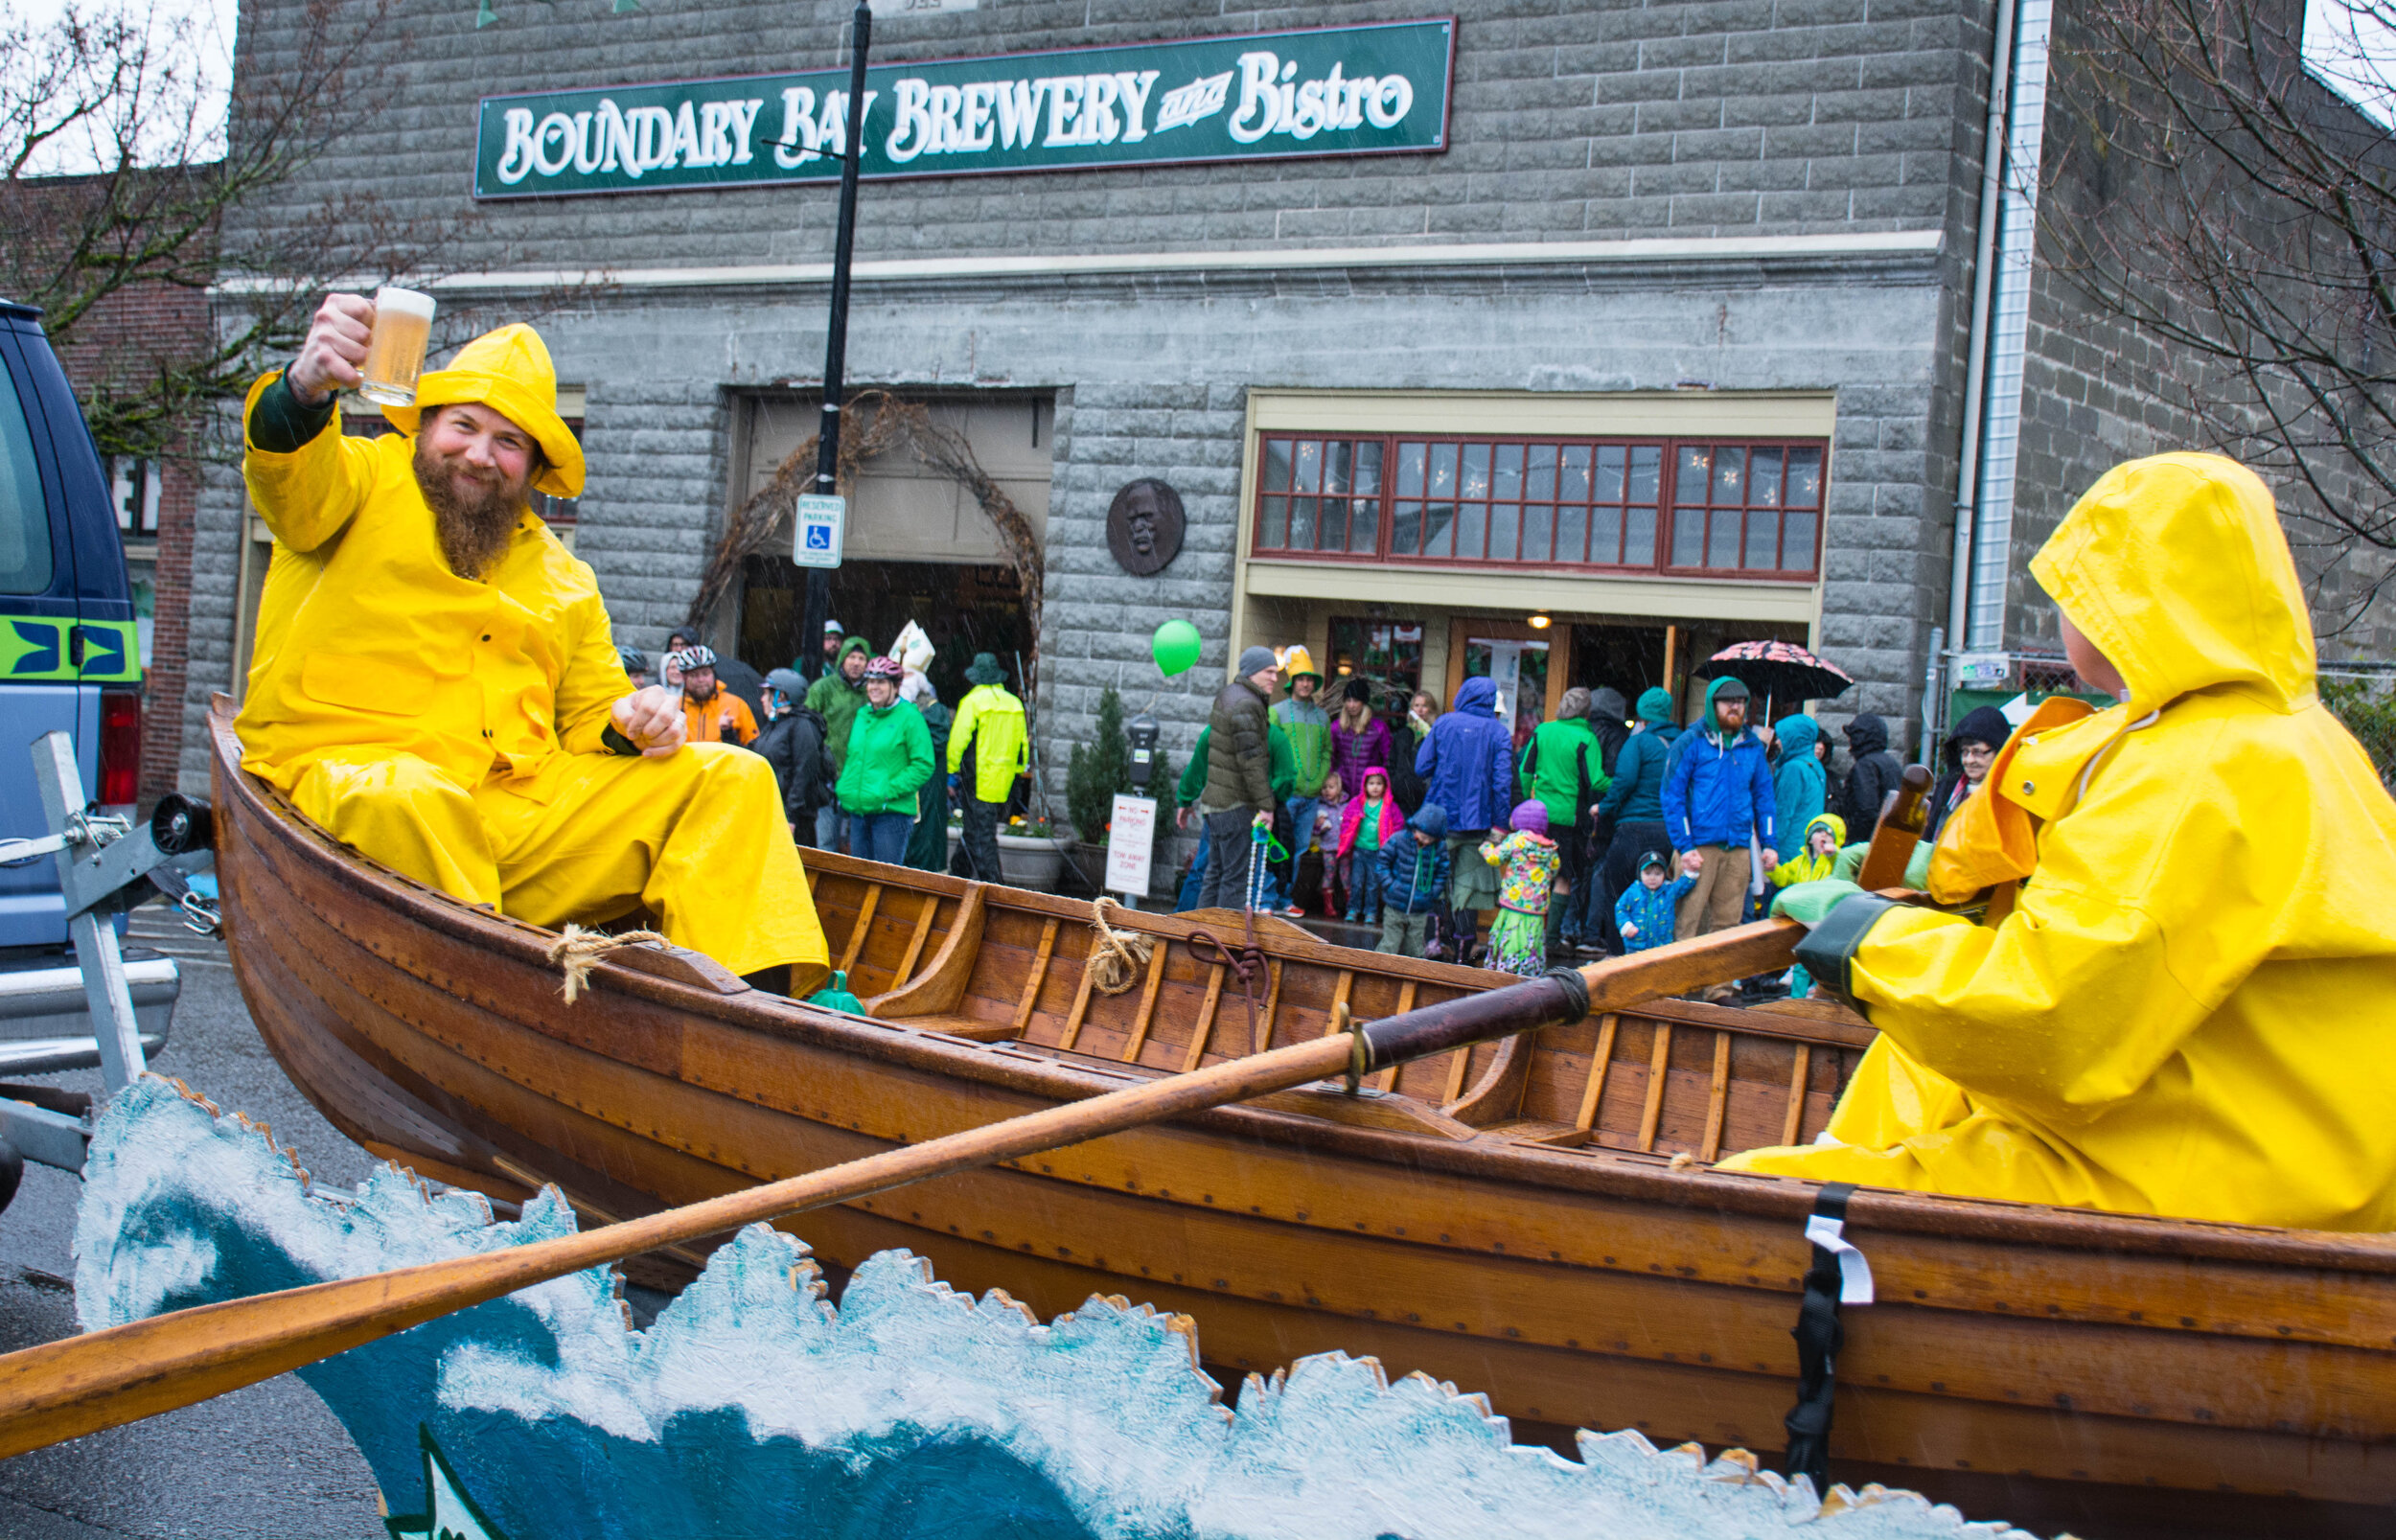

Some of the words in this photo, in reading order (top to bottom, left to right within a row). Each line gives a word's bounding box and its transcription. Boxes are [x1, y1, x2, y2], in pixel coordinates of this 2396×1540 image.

[497, 98, 764, 185] BOUNDARY
[774, 87, 878, 170] BAY
[886, 70, 1161, 163] BREWERY
[1159, 73, 1233, 128] and
[1229, 51, 1414, 144] Bistro
[803, 513, 837, 522] PARKING
[1118, 816, 1146, 825] PARKING
[1114, 850, 1126, 859] TOW
[1128, 853, 1145, 862] AWAY
[1119, 861, 1136, 870] ZONE
